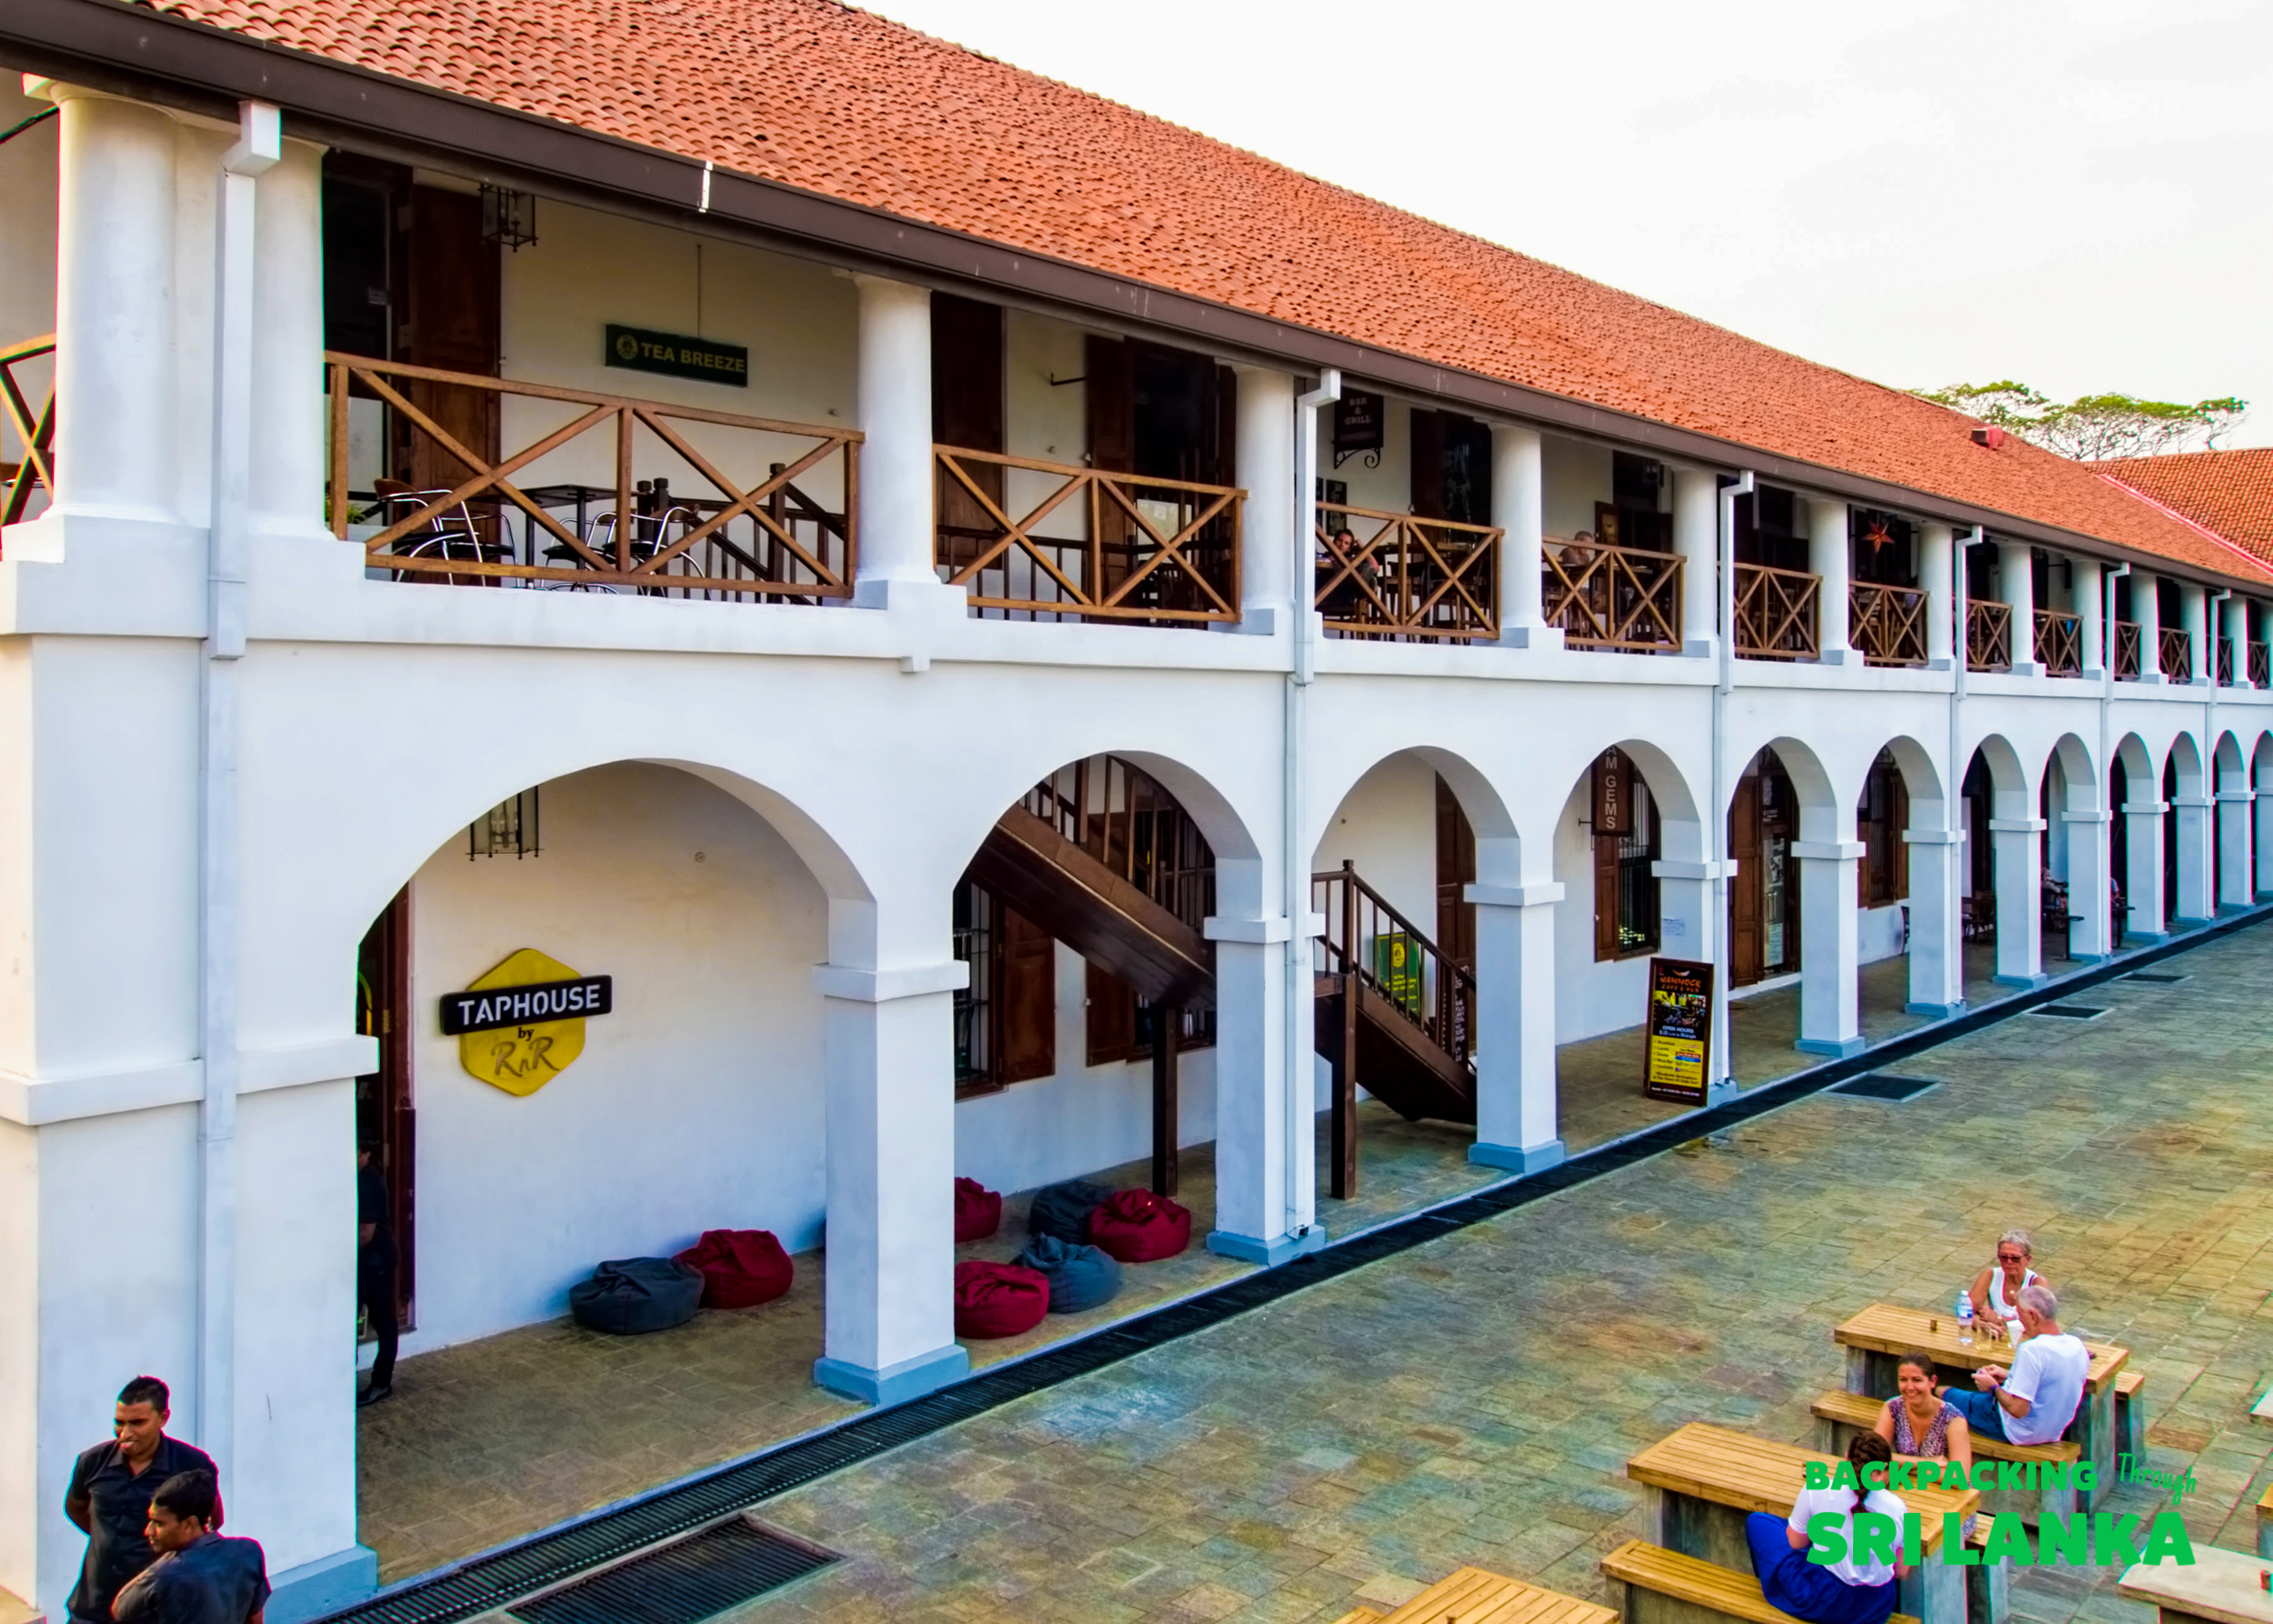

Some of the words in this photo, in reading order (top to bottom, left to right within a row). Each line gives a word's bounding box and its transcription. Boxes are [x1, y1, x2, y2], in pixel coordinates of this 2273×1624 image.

[641, 342, 675, 362] TEA
[681, 349, 746, 373] BREEZE
[1349, 397, 1367, 406] BAR
[1345, 416, 1371, 425] GRILL
[1605, 775, 1617, 829] GEMS
[1660, 977, 1702, 987] HAMMOCK
[457, 984, 601, 1026] TAPHOUSE
[517, 1027, 535, 1041] by
[491, 1036, 560, 1078] RnR
